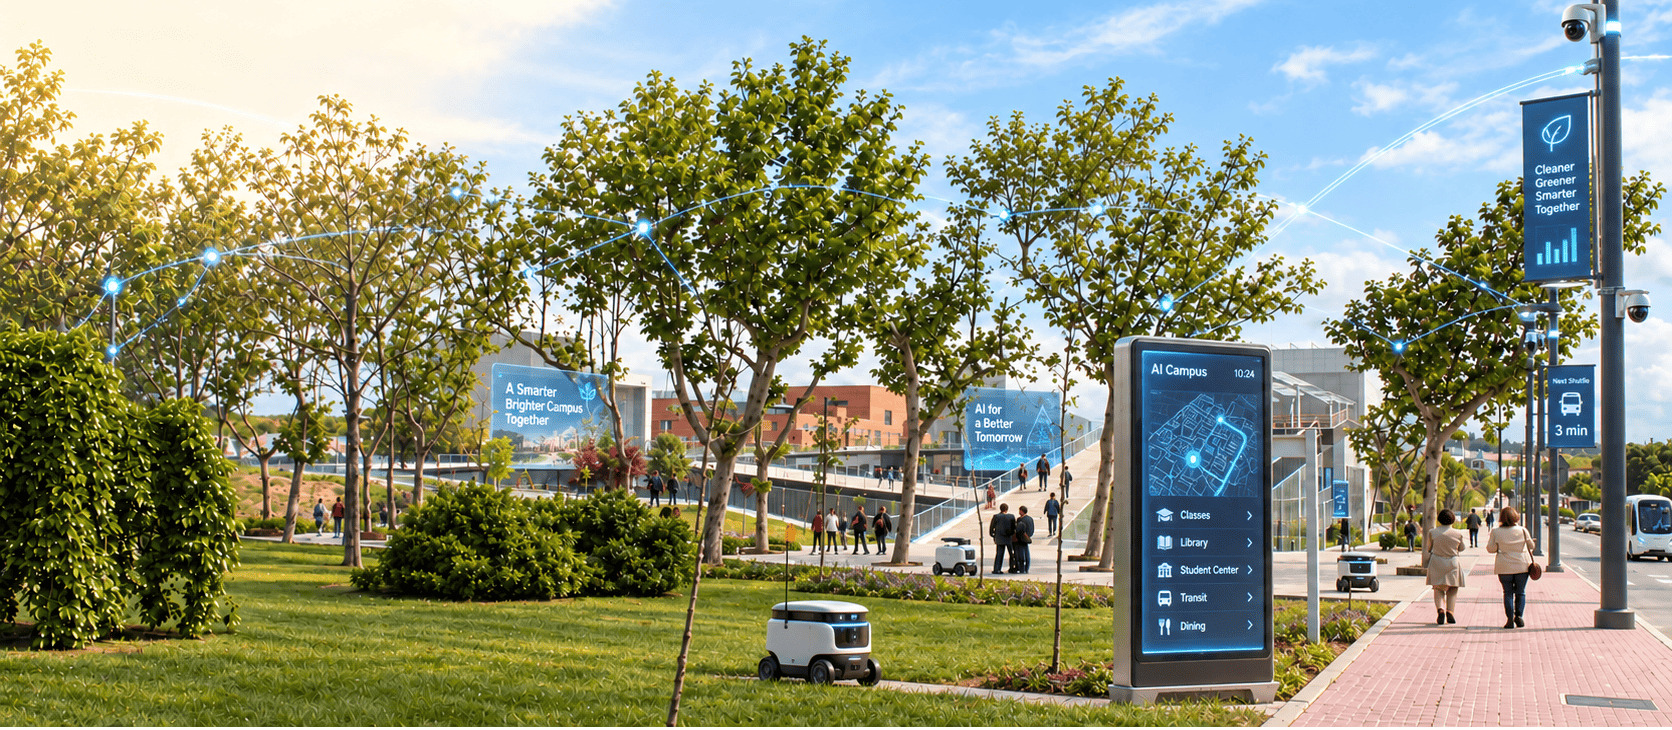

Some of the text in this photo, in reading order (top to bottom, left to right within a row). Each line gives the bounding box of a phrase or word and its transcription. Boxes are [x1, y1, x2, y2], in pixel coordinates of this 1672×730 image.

[1535, 163, 1575, 175] Cleaner
[1535, 175, 1576, 188] Greener
[1535, 189, 1577, 201] Smarter
[1535, 202, 1580, 216] Together
[1151, 363, 1207, 378] AI Campus
[1234, 369, 1255, 378] 10:24
[505, 382, 557, 397] A Smarter
[505, 399, 583, 415] Brighter Campus
[975, 403, 1002, 415] AI for
[505, 413, 549, 427] Together
[975, 418, 1013, 429] a Better
[1555, 424, 1588, 436] 3 min
[975, 431, 1023, 442] Tomorrow
[1180, 510, 1210, 520] Classes
[1180, 537, 1208, 549] Library
[1180, 565, 1239, 575] Student Center
[1180, 593, 1207, 602] Transit
[1180, 621, 1206, 632] Dining
